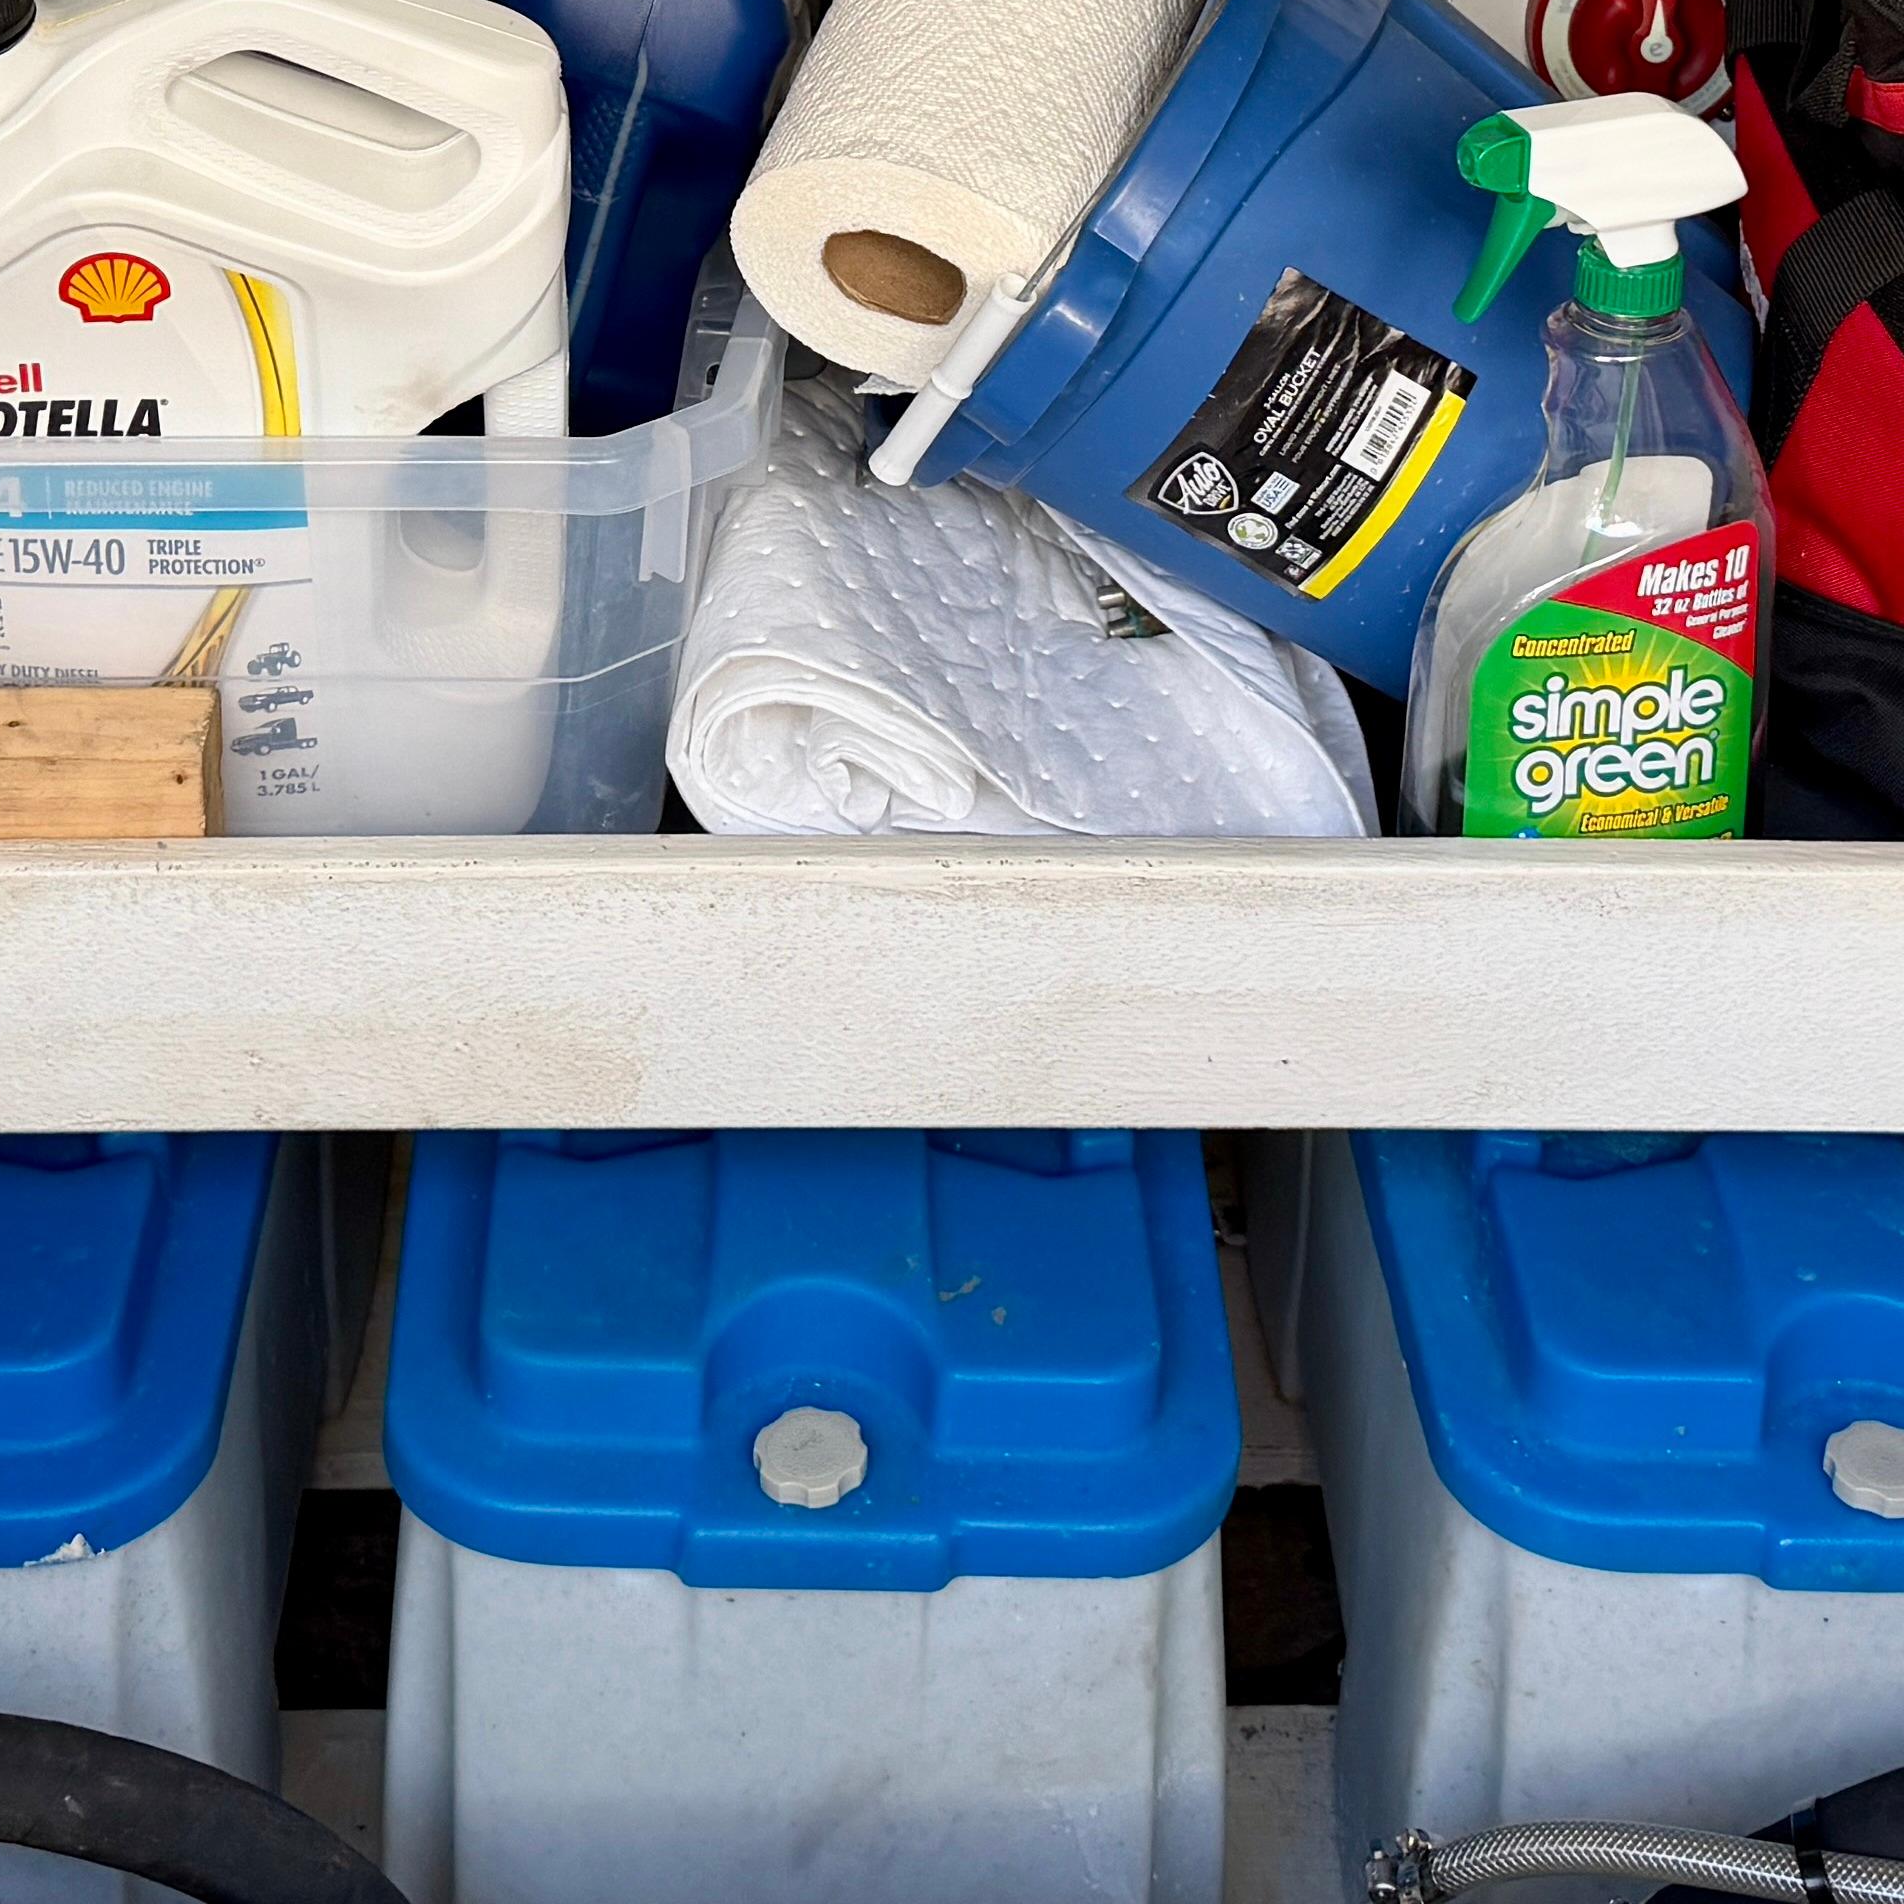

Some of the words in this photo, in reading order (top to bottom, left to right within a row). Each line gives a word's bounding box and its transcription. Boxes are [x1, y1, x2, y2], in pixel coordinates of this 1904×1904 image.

[1253, 405, 1285, 445] OVAL
[1278, 346, 1321, 406] BUCKET
[64, 480, 144, 497] REDUCED
[149, 481, 214, 497] ENGINE
[9, 537, 125, 576] 15W-40
[147, 539, 201, 556] TRIPLE
[148, 558, 255, 575] PROTECTION
[1637, 556, 1717, 597] Makes
[1725, 545, 1750, 580] 10
[1651, 597, 1671, 616] 32
[1674, 599, 1690, 614] oz
[1693, 587, 1734, 609] Bottles
[1512, 630, 1635, 657] Concentrated
[1511, 668, 1725, 746] simple
[257, 783, 308, 797] 3.785
[1515, 740, 1715, 814] green
[1581, 808, 1658, 832] Economical
[1661, 806, 1672, 823] &
